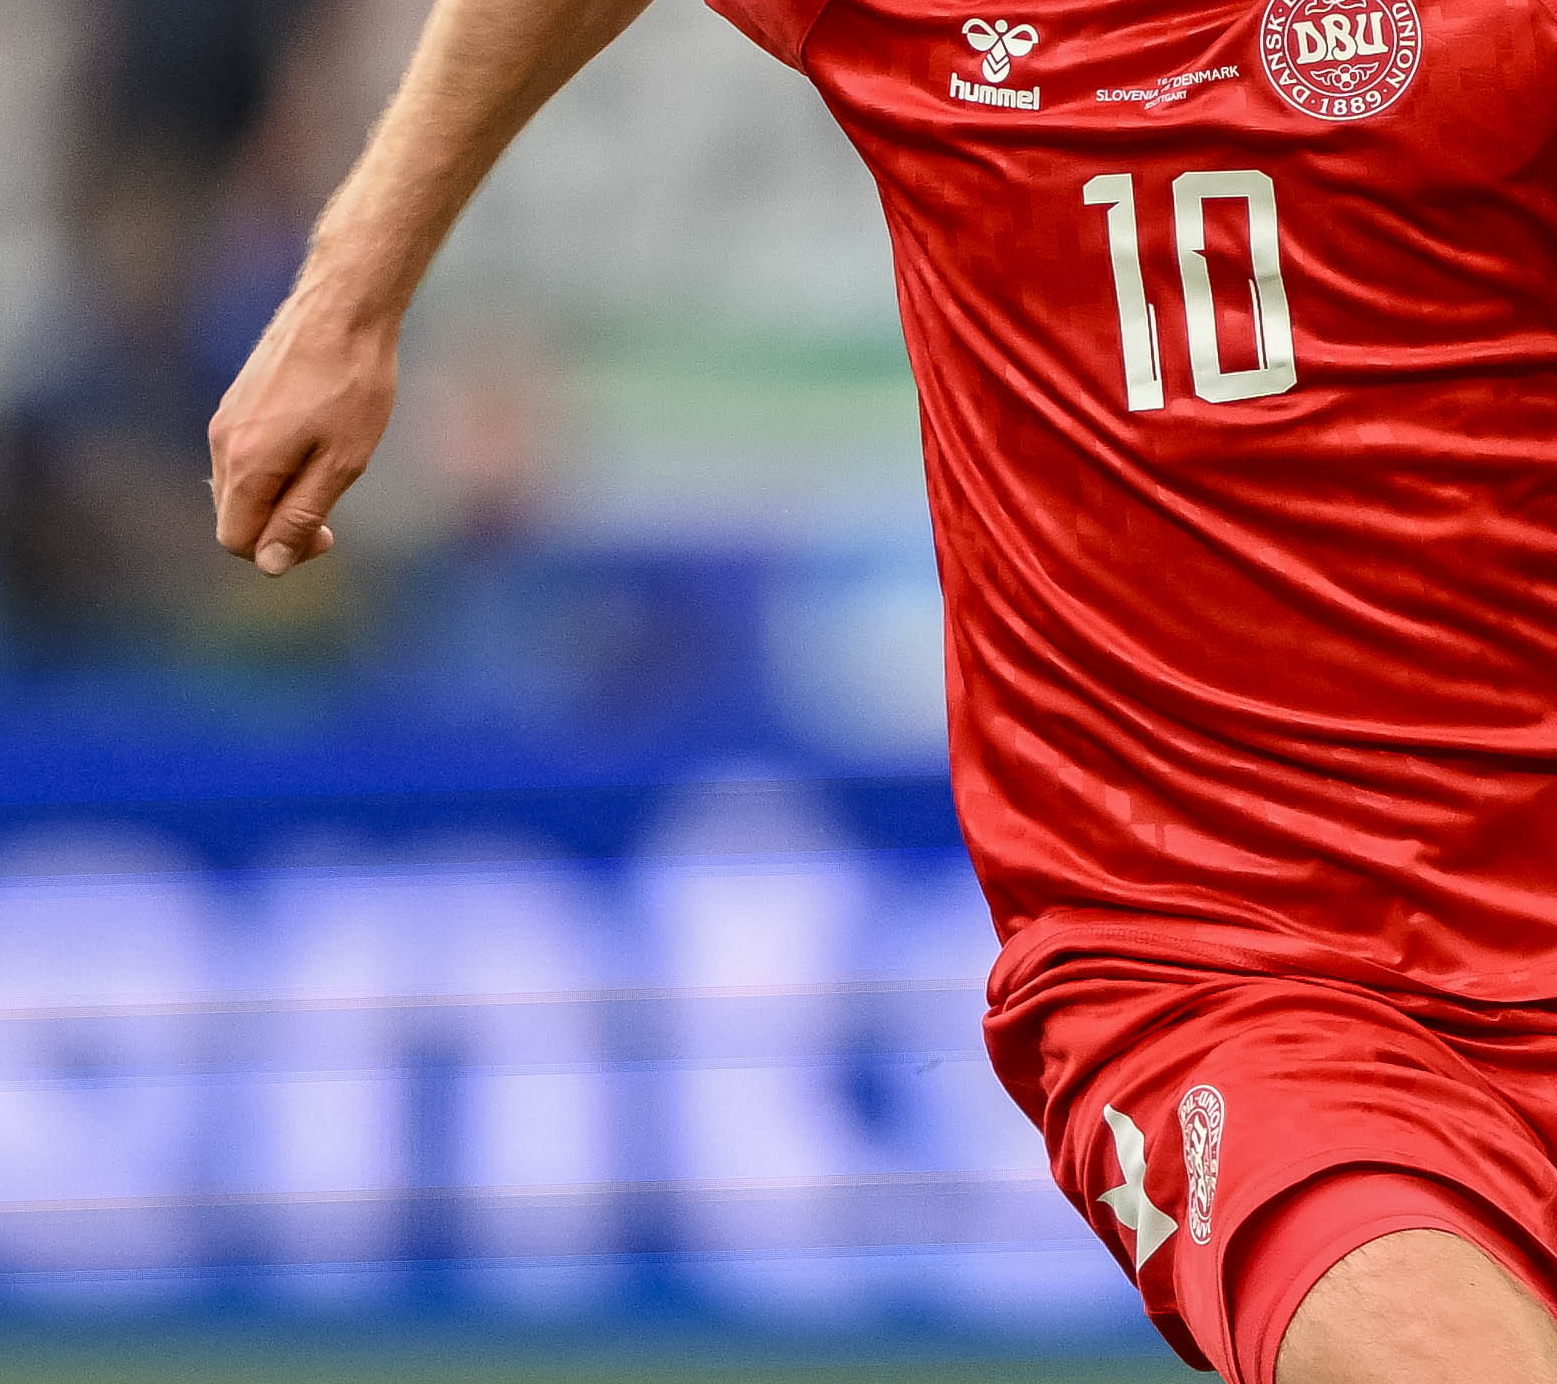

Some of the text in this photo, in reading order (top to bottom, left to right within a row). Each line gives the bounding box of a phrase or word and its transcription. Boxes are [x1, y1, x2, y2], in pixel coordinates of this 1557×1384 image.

[1266, 13, 1312, 105] DANSK
[1292, 11, 1390, 65] DBU
[949, 72, 1041, 111] hummel
[1095, 88, 1159, 102] SLOVENIA
[1172, 65, 1241, 88] DENMARK
[1319, 90, 1383, 116] 1889
[1082, 170, 1299, 413] 10
